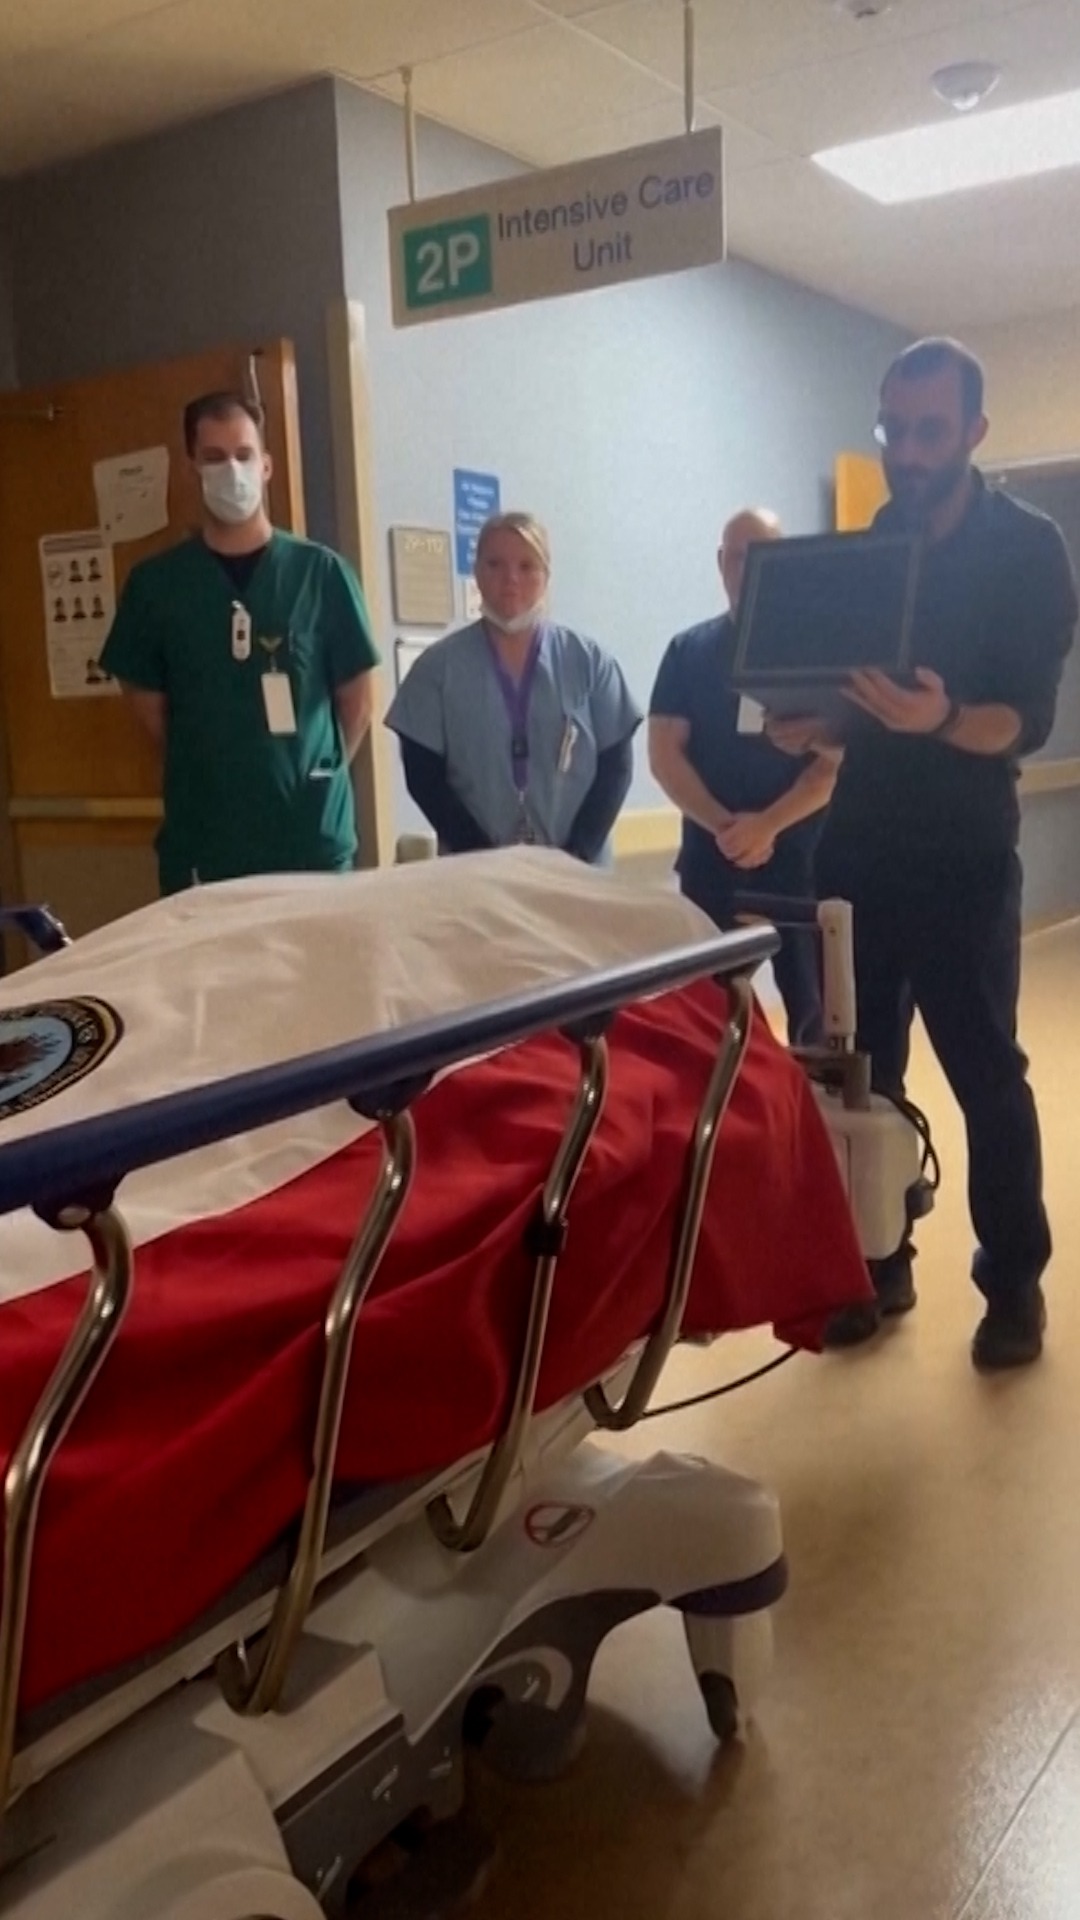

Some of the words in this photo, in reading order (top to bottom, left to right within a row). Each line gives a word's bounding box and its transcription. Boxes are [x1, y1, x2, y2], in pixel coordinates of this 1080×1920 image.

[497, 190, 629, 241] Intensive
[638, 172, 715, 210] Care
[416, 231, 480, 294] 2P
[573, 231, 632, 272] Unit
